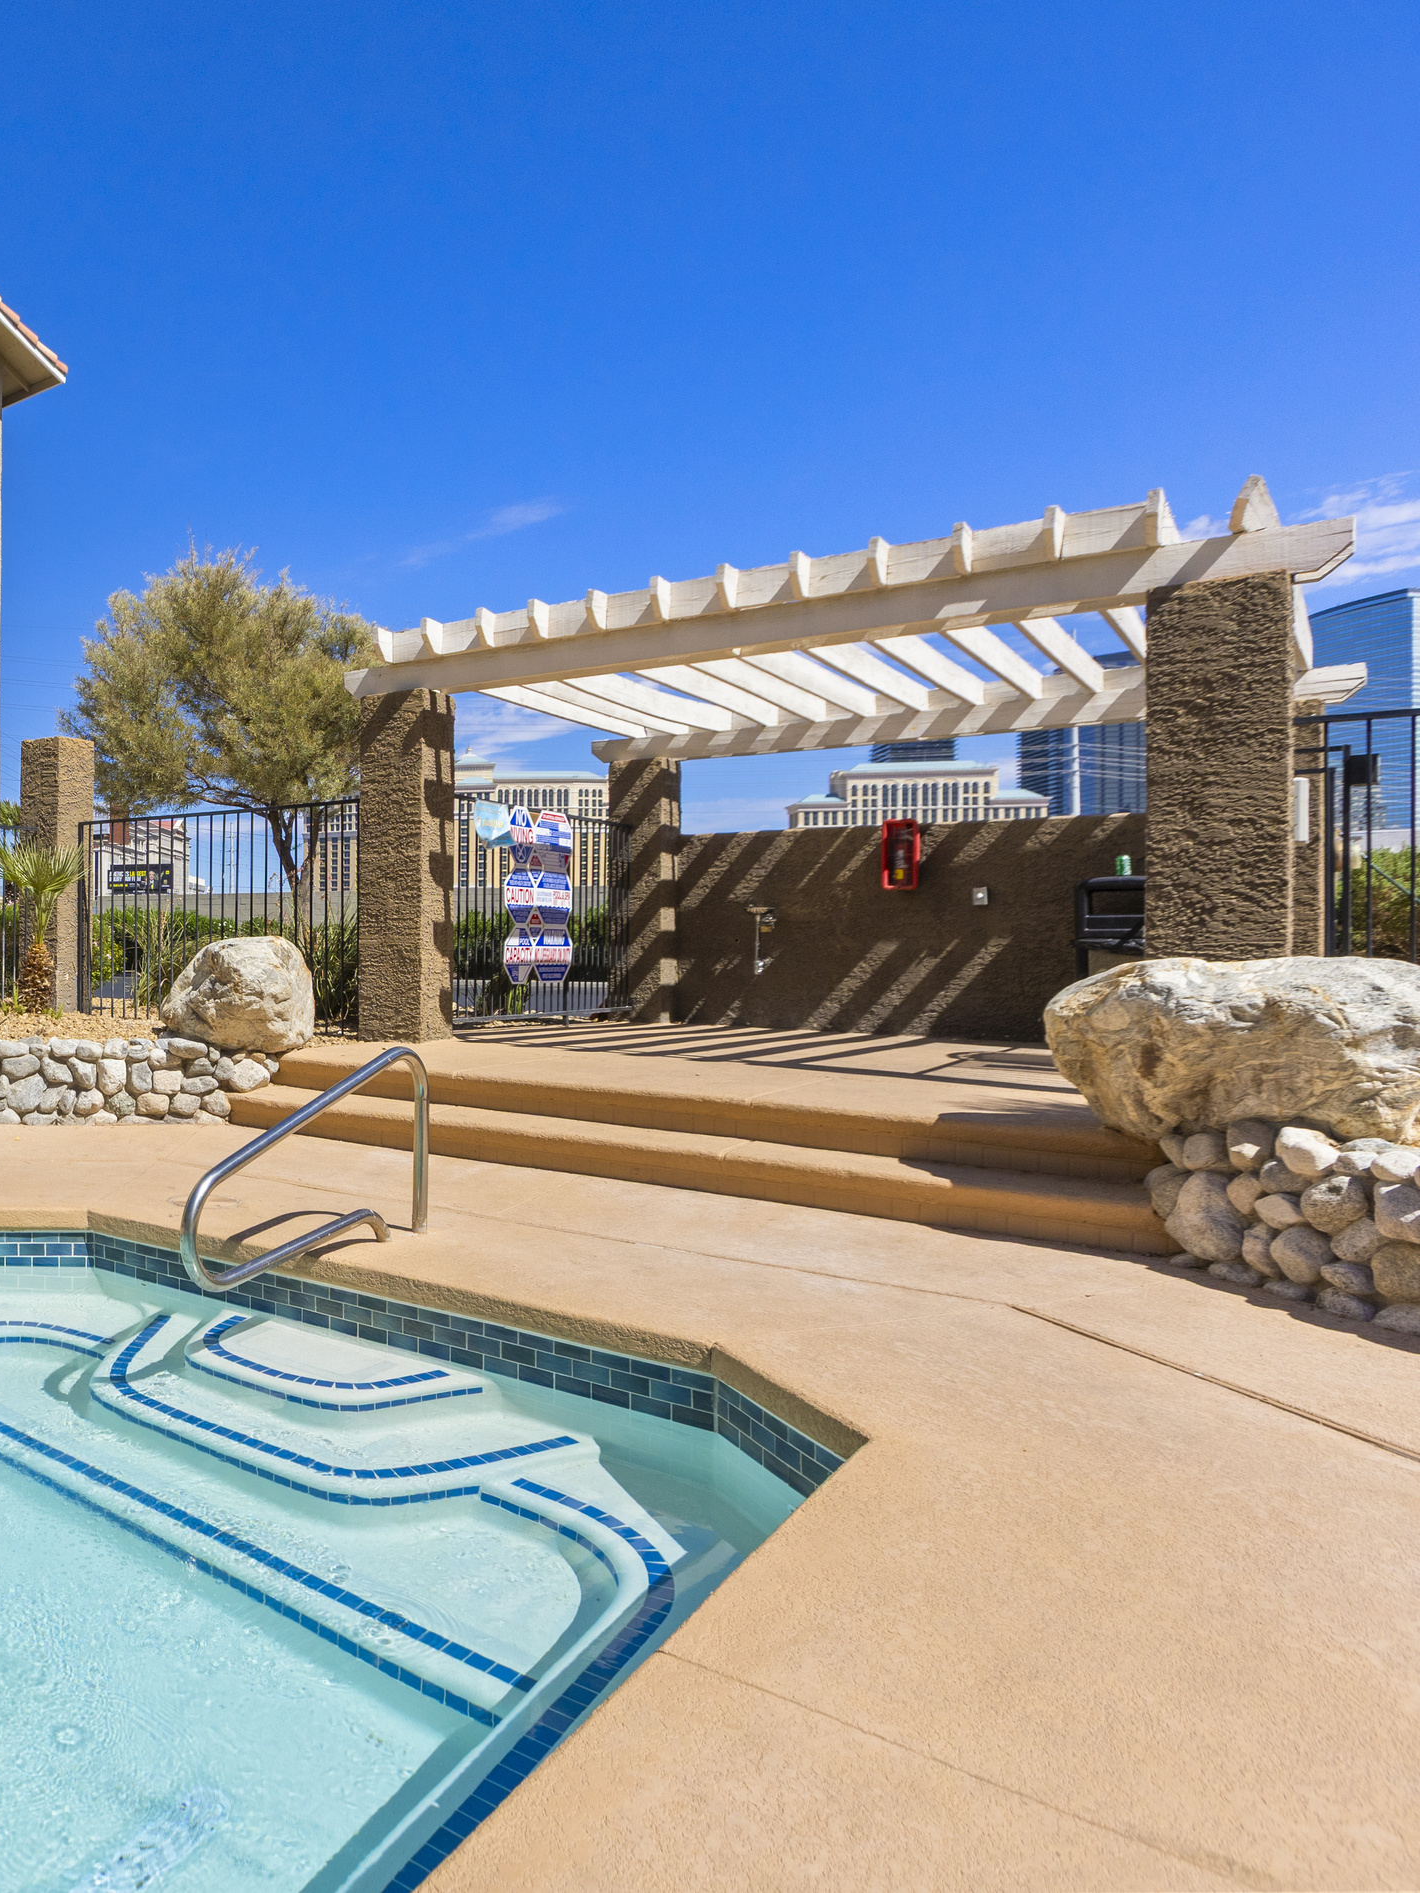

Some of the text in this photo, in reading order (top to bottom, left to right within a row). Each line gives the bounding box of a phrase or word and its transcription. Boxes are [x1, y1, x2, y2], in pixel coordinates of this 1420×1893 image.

[516, 809, 527, 827] NO
[510, 826, 534, 844] IVING
[506, 887, 534, 904] CAUTION
[506, 947, 533, 963] CAPACITY
